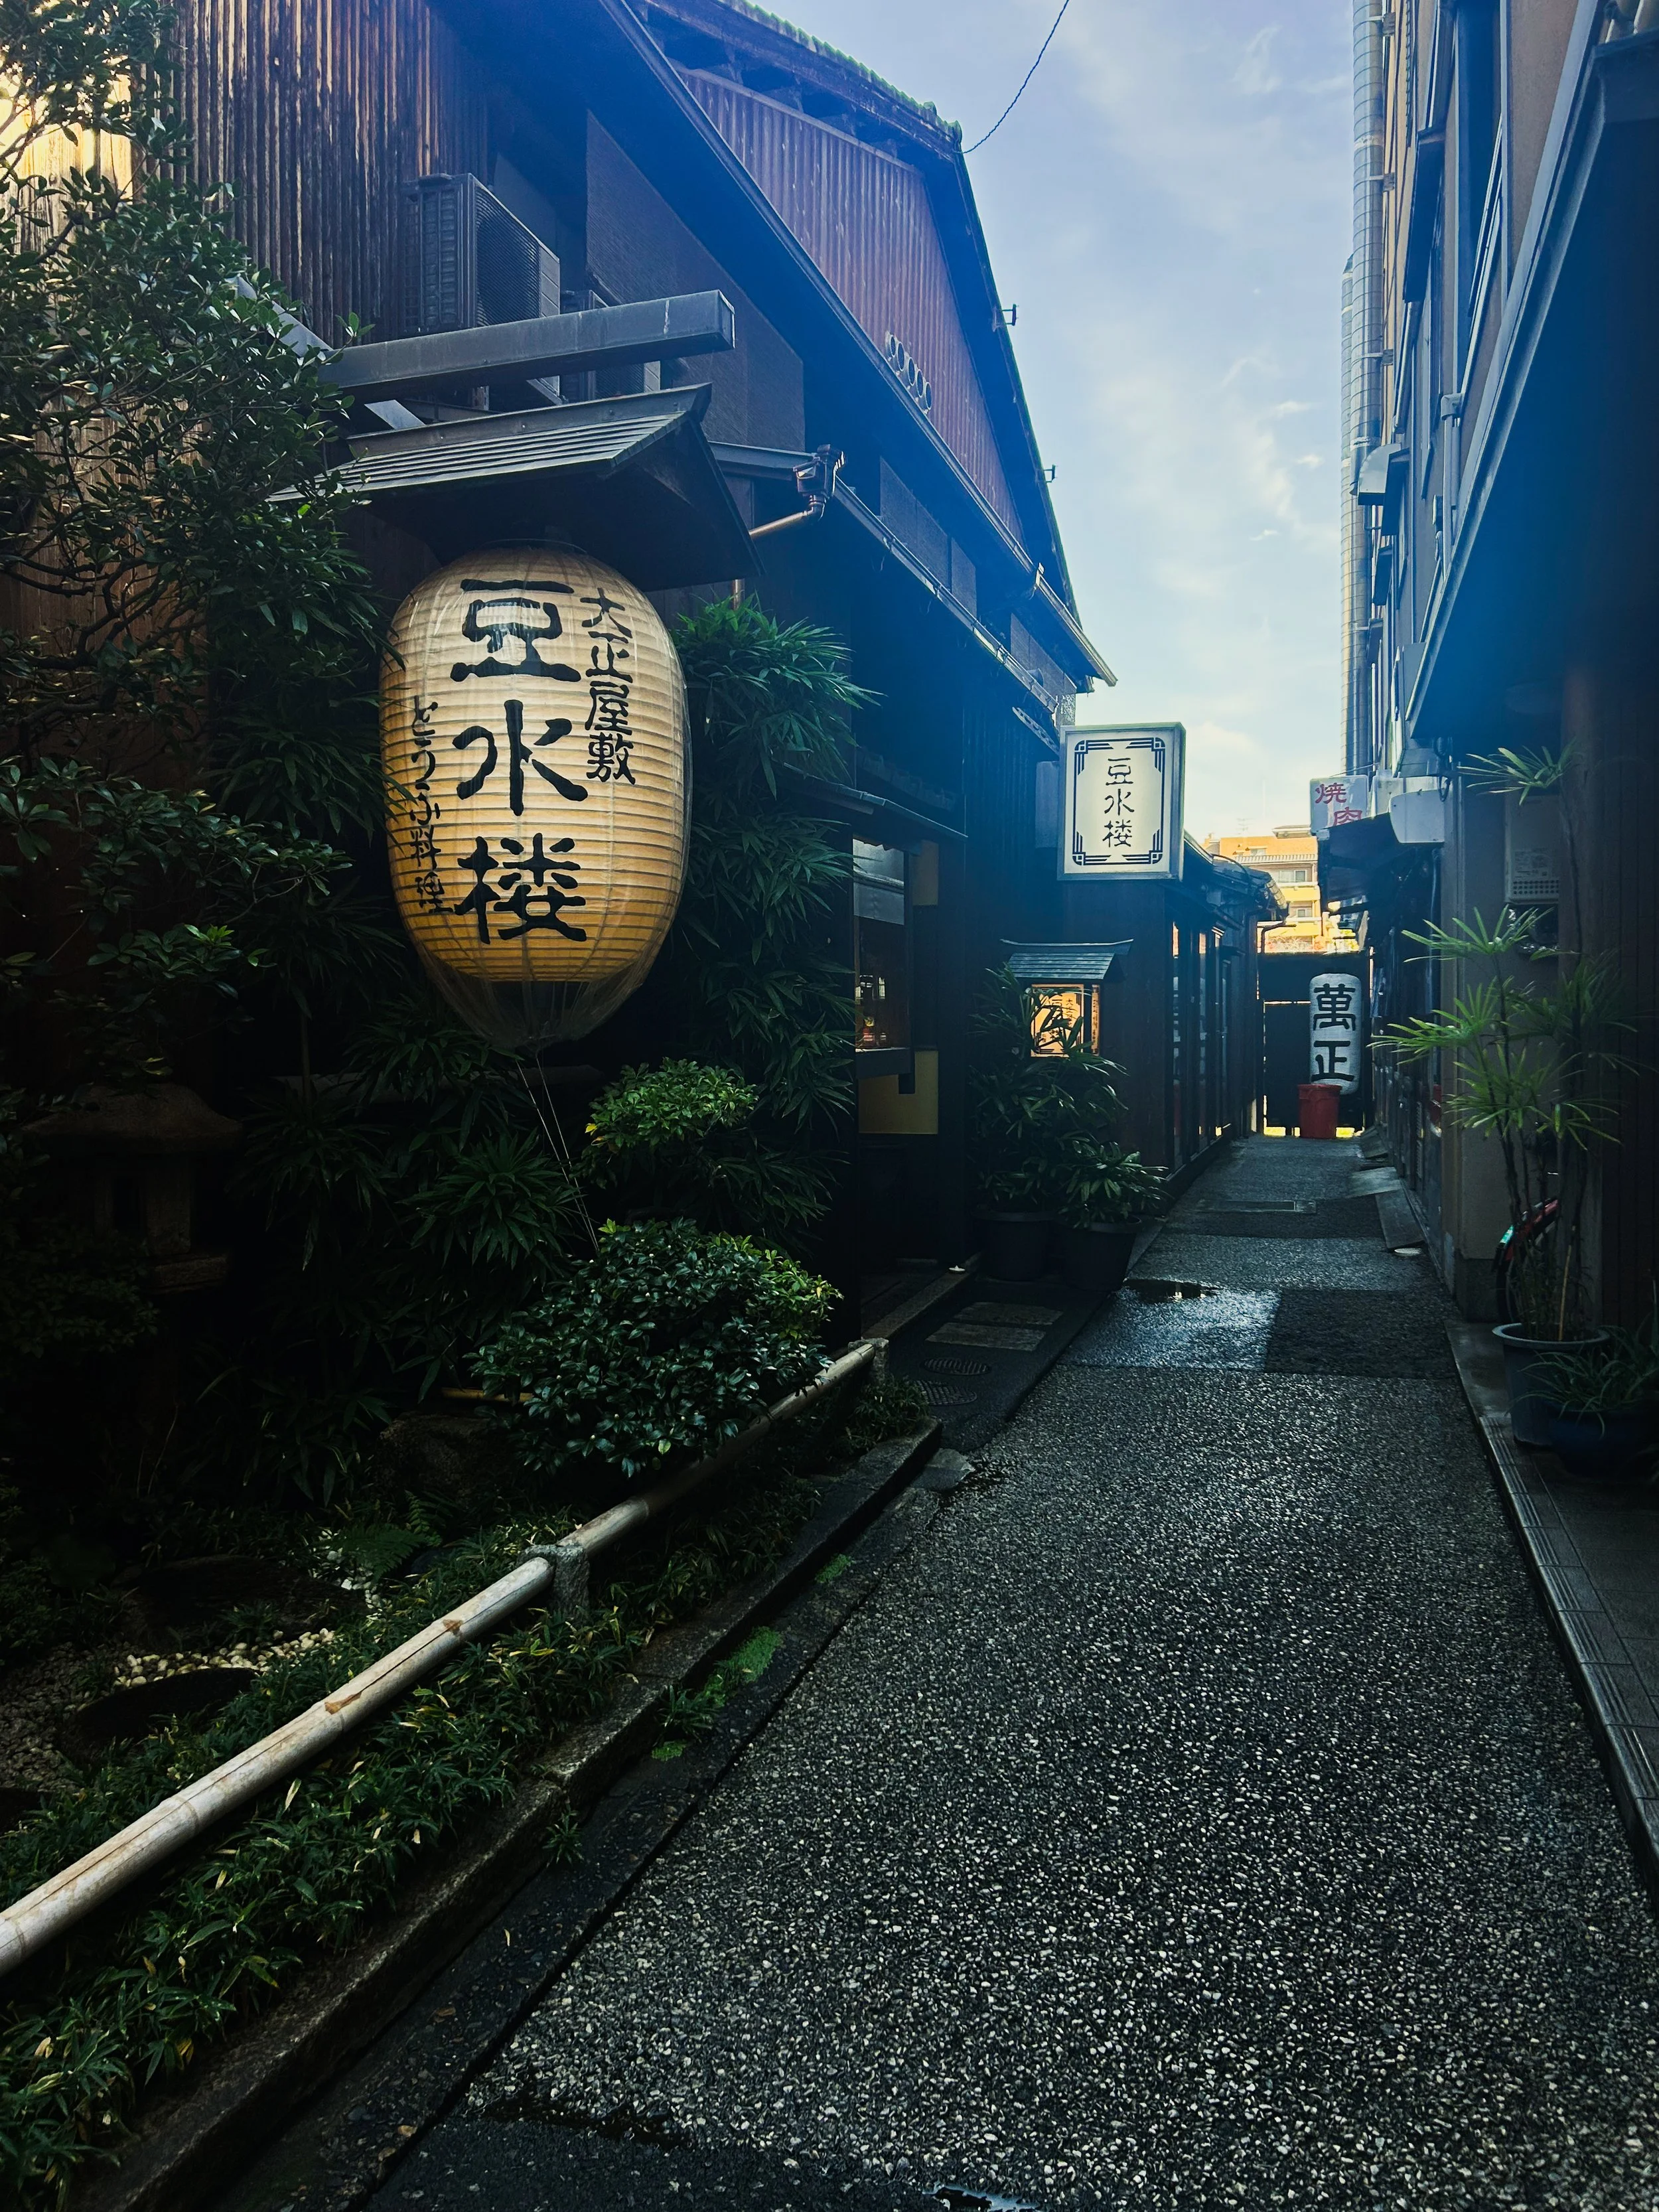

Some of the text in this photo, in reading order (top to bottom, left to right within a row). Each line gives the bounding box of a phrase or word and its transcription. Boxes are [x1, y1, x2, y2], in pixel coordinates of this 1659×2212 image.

[580, 588, 636, 784] 大正屋敷
[409, 696, 454, 913] とうふ料理
[450, 579, 589, 944] 豆水楼
[1102, 757, 1135, 848] 豆水楼
[1315, 782, 1363, 826] 焼肉
[1311, 984, 1356, 1081] 萬正
